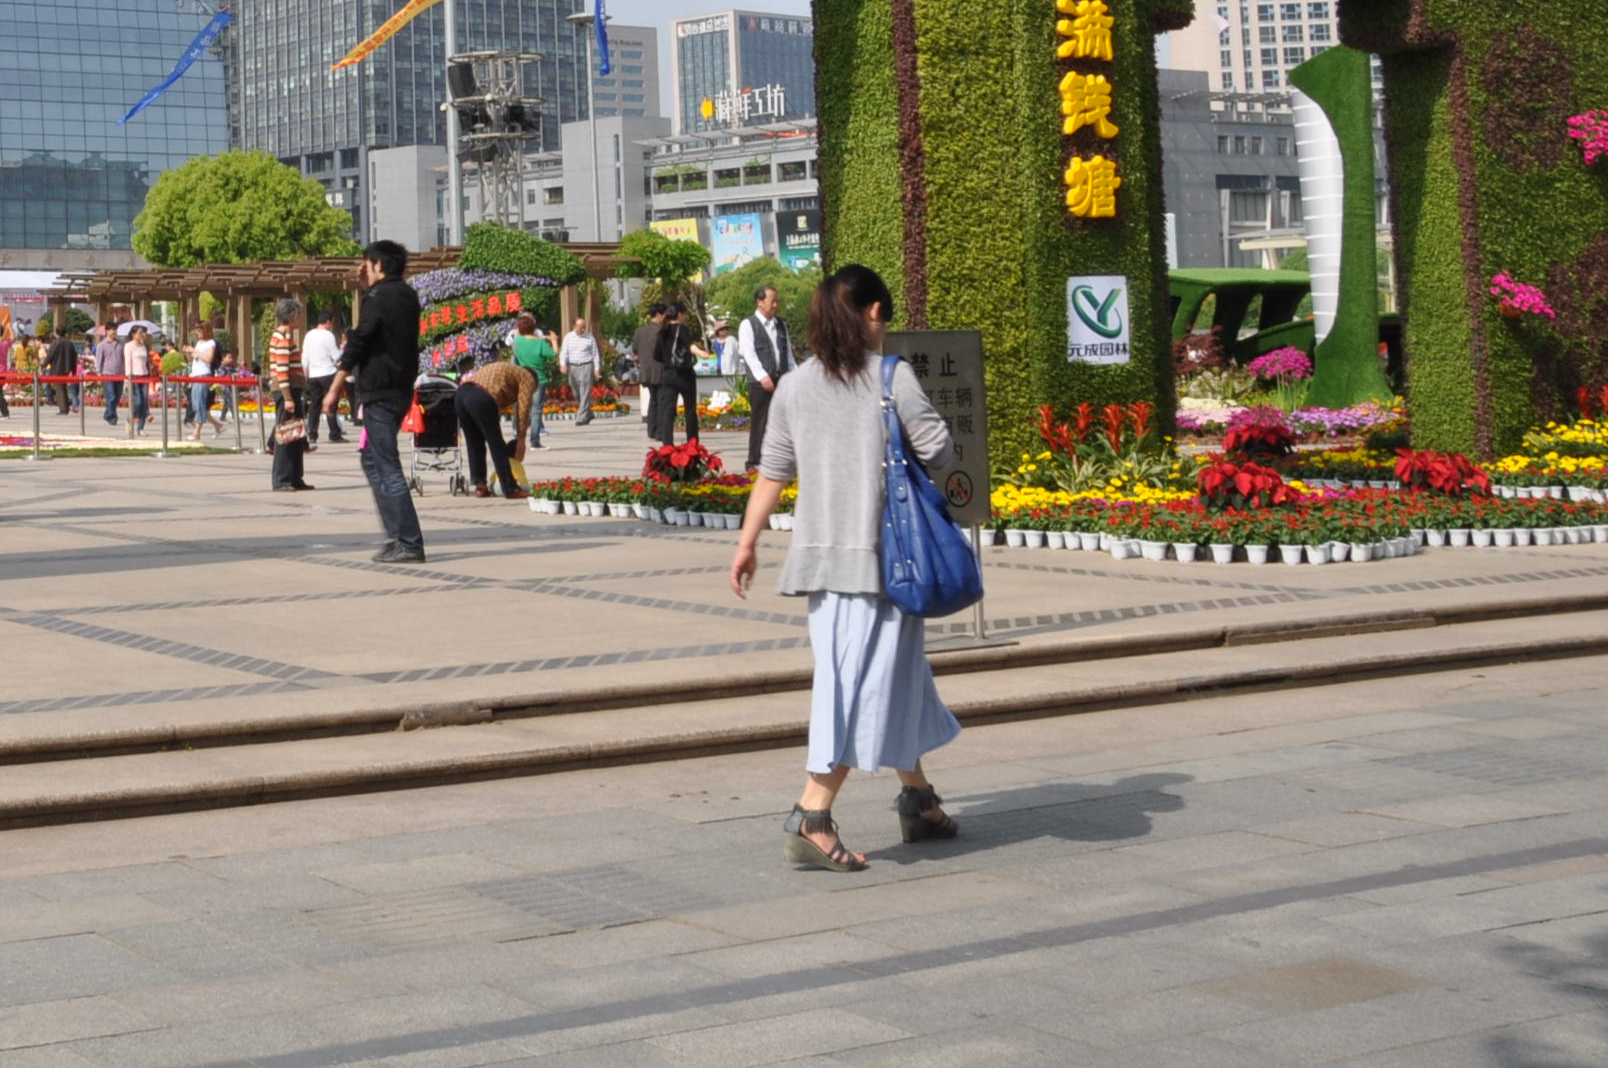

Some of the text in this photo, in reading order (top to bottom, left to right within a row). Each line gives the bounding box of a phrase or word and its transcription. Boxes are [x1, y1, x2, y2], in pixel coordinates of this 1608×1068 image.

[1068, 342, 1129, 358] 元成园林
[911, 352, 958, 378] 禁止
